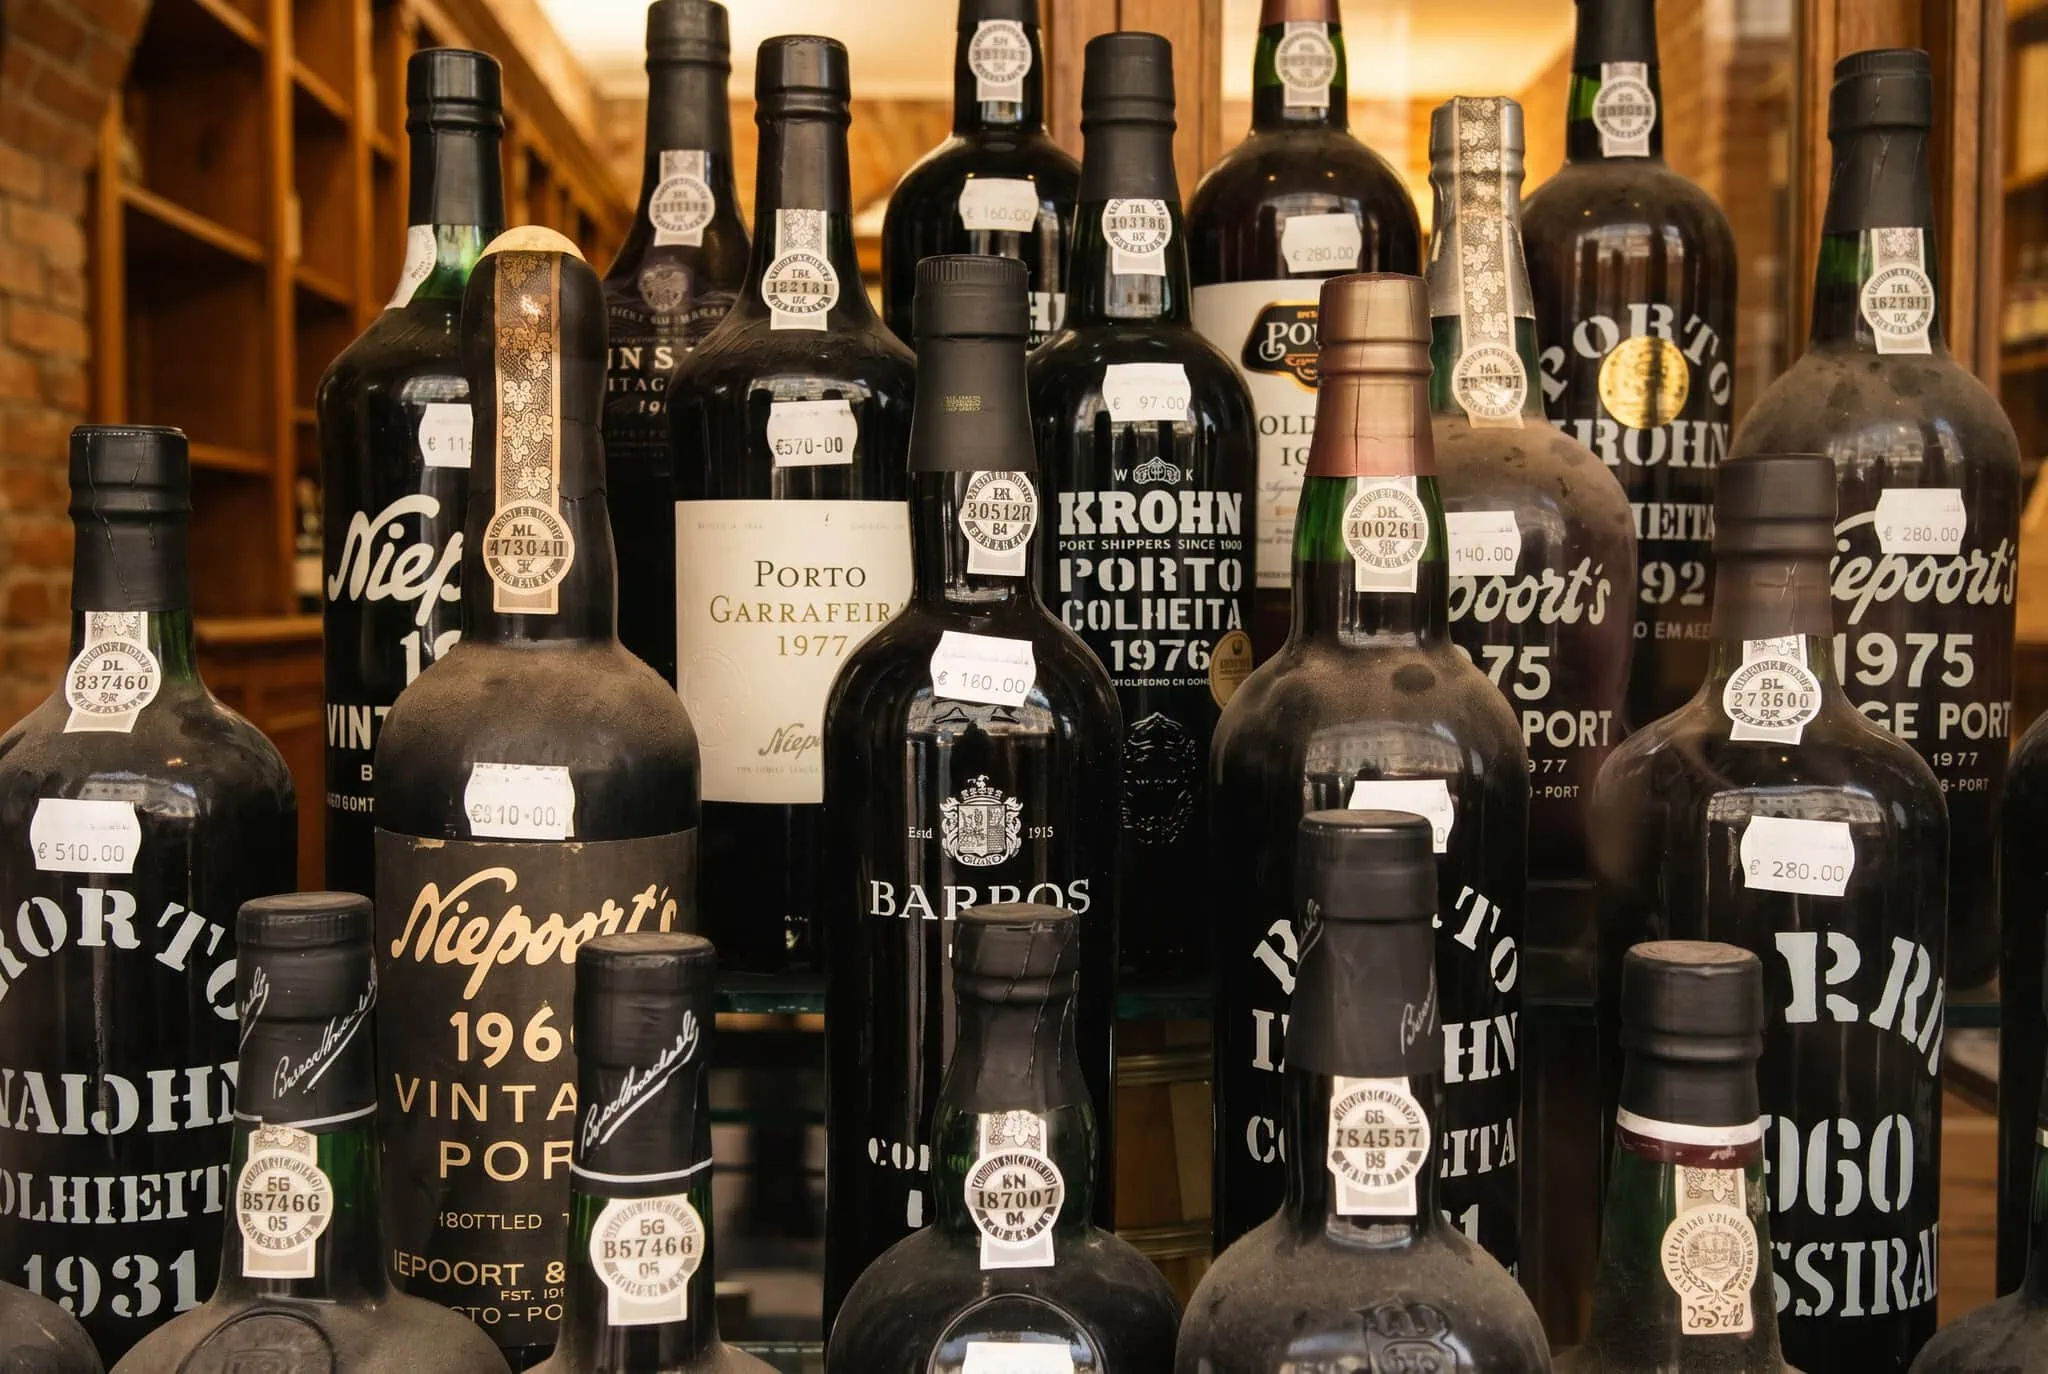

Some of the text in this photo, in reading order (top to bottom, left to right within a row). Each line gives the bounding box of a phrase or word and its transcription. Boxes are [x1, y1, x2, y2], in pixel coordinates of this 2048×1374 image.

[1139, 396, 1185, 410] 97.00
[1114, 469, 1193, 481] W K
[1058, 490, 1242, 535] KROHN
[1350, 521, 1419, 539] 400261
[1903, 526, 1959, 543] 280.00
[1059, 540, 1095, 551] PORT
[1101, 539, 1171, 550] SHIPPERS
[1178, 539, 1215, 550] SINCE
[1455, 546, 1514, 562] 140.00
[754, 560, 866, 588] PORTO
[1059, 557, 1242, 592] PORTO
[709, 595, 905, 623] GARRAFEIR
[1061, 598, 1242, 631] COLHEITA
[777, 636, 848, 657] 1977
[1110, 639, 1210, 671] 1976
[101, 659, 124, 672] DL
[1832, 632, 1974, 688] 1975
[75, 675, 148, 691] 837460
[1760, 678, 1784, 690] BL
[1523, 710, 1612, 748] PORT
[1939, 702, 2012, 740] PORT
[1933, 752, 1979, 767] 1977
[1028, 826, 1054, 839] 1915
[55, 843, 125, 863] 510.00
[1772, 860, 1845, 882] 280.00
[449, 1006, 574, 1069] 196
[977, 1188, 1057, 1210] 187007
[23, 1249, 204, 1318] 1931
